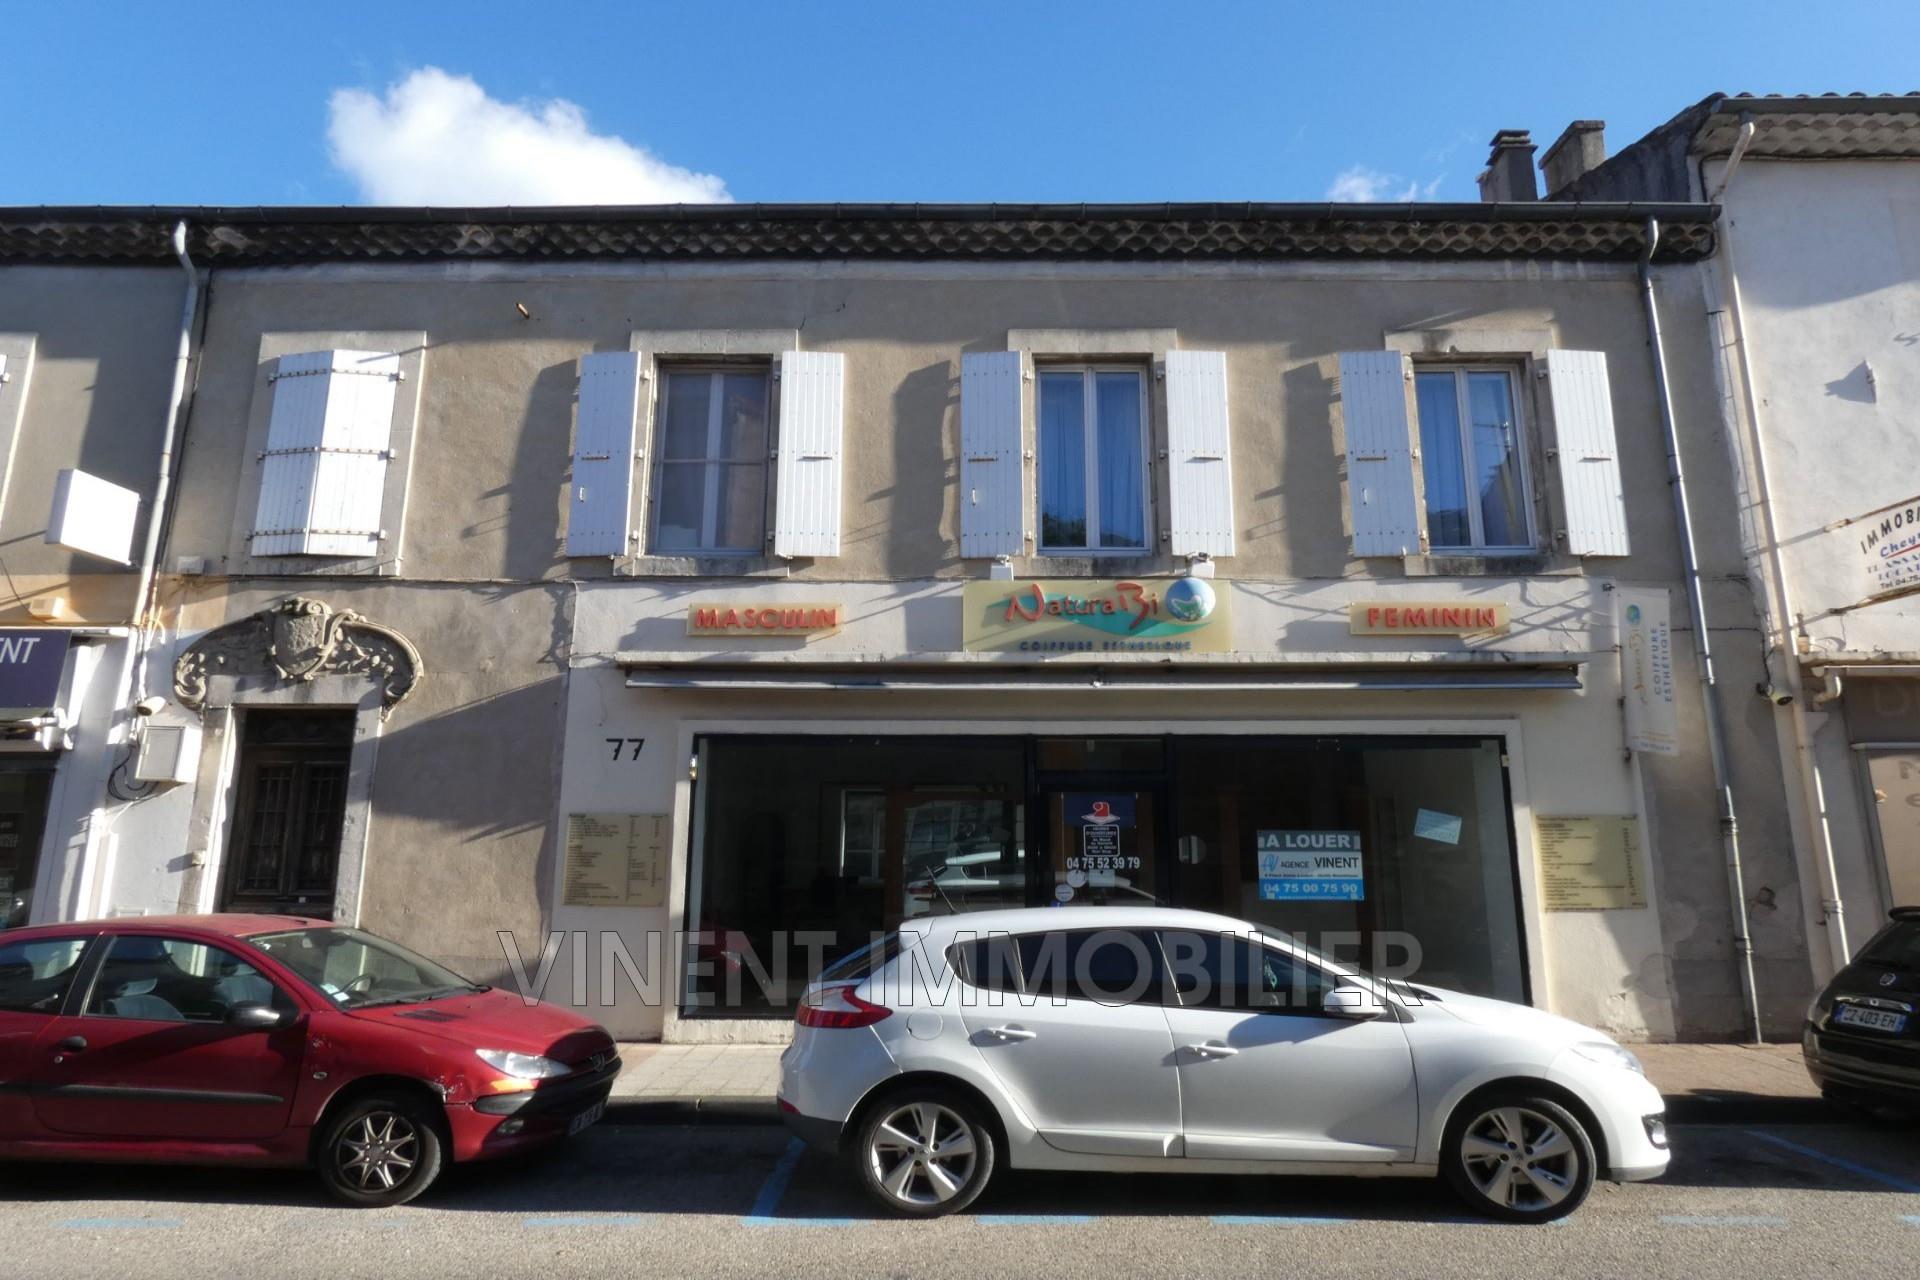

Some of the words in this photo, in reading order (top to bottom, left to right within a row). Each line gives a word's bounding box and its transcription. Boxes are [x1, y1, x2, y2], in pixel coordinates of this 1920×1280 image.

[695, 608, 836, 629] MASCULIN
[1367, 607, 1496, 628] FEMININ
[0, 637, 41, 664] NT
[1020, 641, 1093, 651] COIFFURE
[1651, 628, 1662, 696] COIFFURE
[606, 738, 645, 761] 77
[1266, 834, 1280, 848] A
[1285, 834, 1351, 848] LOUER
[1066, 857, 1079, 869] 04
[1082, 857, 1094, 869] 75
[1097, 857, 1110, 869] 52
[1128, 857, 1140, 869] 79
[1280, 861, 1310, 869] AGENCE
[1314, 857, 1359, 869] VINENT
[1263, 884, 1280, 893] 04
[1283, 884, 1299, 893] 75
[1322, 884, 1338, 893] 75
